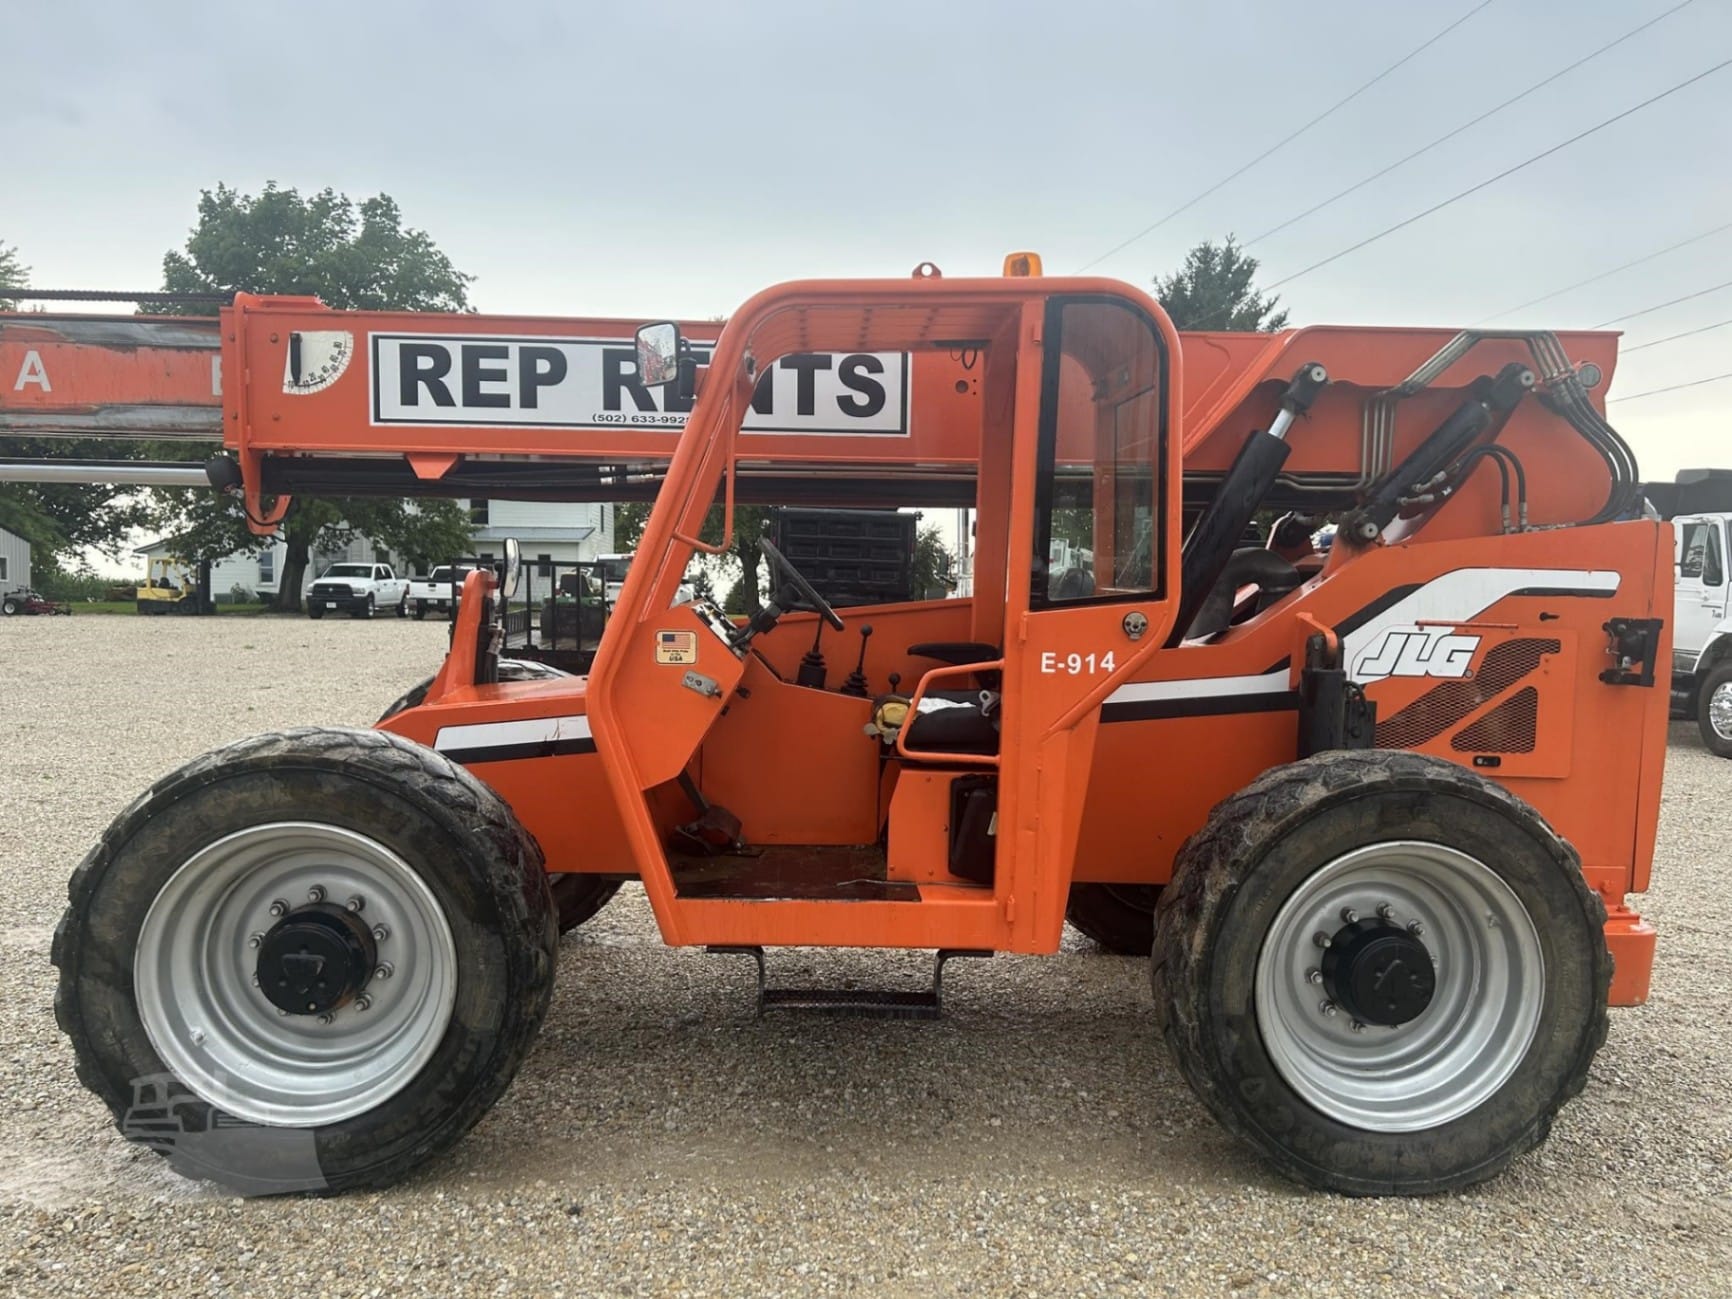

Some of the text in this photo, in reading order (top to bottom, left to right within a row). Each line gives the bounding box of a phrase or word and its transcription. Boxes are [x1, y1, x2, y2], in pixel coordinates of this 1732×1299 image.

[14, 350, 52, 392] A
[400, 343, 568, 409] REP
[592, 413, 689, 425] (502) 633-992
[1041, 650, 1116, 675] E-914
[1356, 631, 1483, 679] JLG
